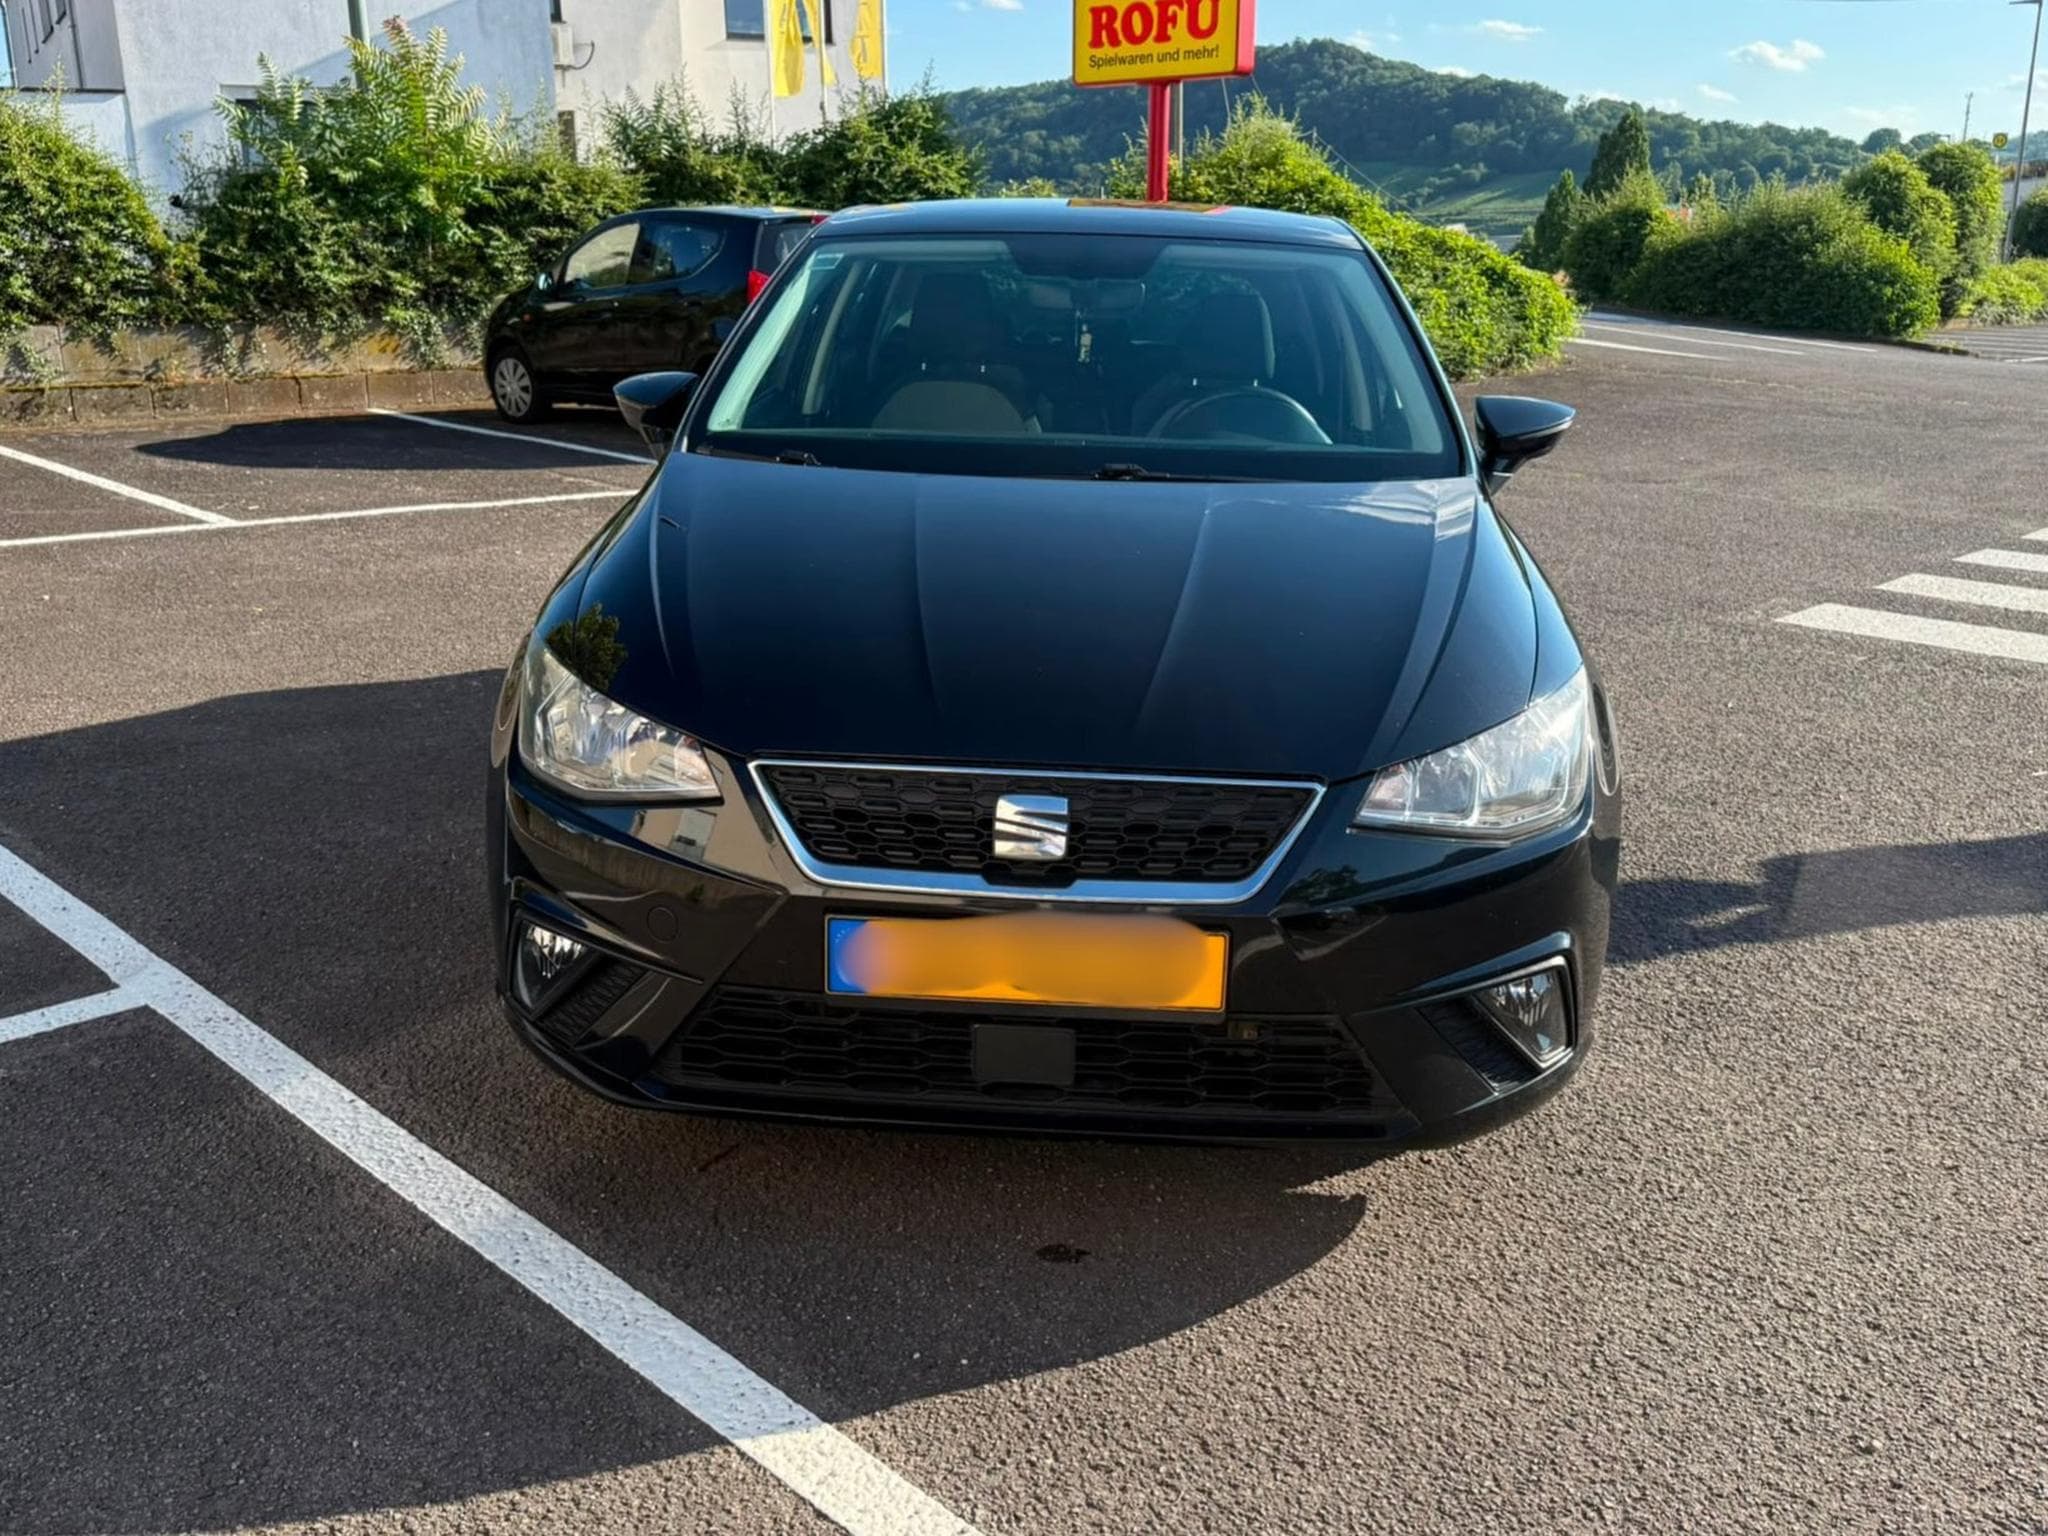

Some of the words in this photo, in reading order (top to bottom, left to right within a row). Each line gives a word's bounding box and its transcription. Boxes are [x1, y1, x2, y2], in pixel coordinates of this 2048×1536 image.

[1088, 0, 1220, 49] ROFU
[1088, 53, 1153, 69] Spielwaren
[1156, 48, 1180, 62] und
[1183, 44, 1220, 60] mehr!
